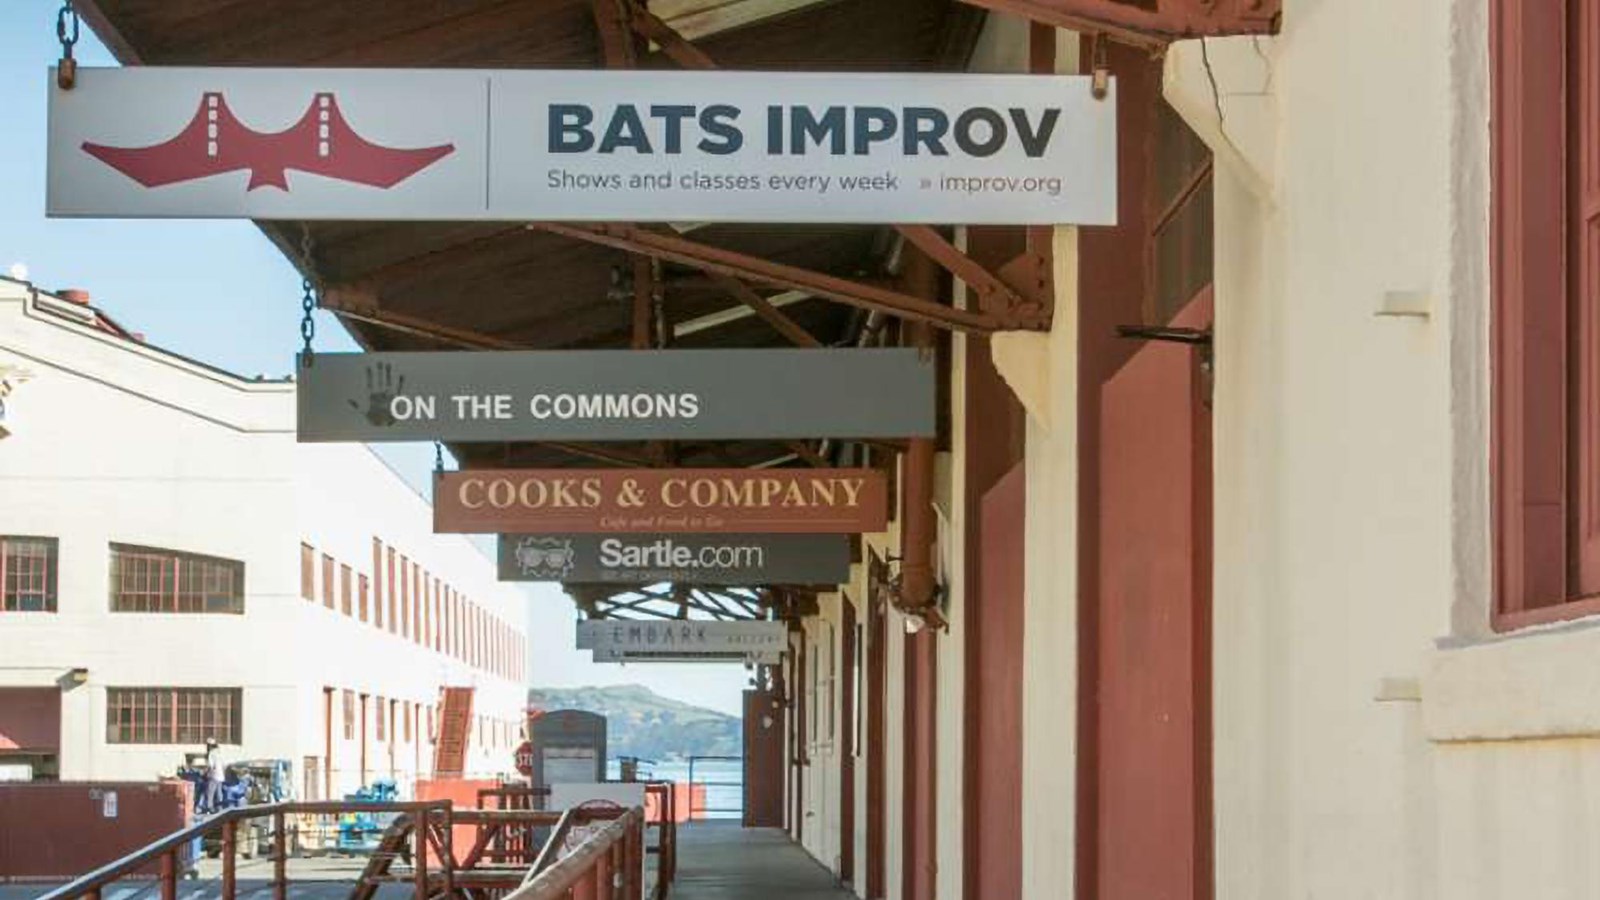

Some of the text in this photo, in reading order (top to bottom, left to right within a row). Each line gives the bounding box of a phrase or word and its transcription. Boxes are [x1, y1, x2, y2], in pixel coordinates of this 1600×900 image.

[548, 104, 1062, 158] BATS IMPROV
[548, 169, 1062, 195] Shows and classes every week improv.org
[390, 392, 699, 421] ON THE COMMONS
[458, 478, 864, 509] COOKS & COMPANY
[600, 539, 763, 568] Sartle.com
[613, 626, 706, 645] EMBARK
